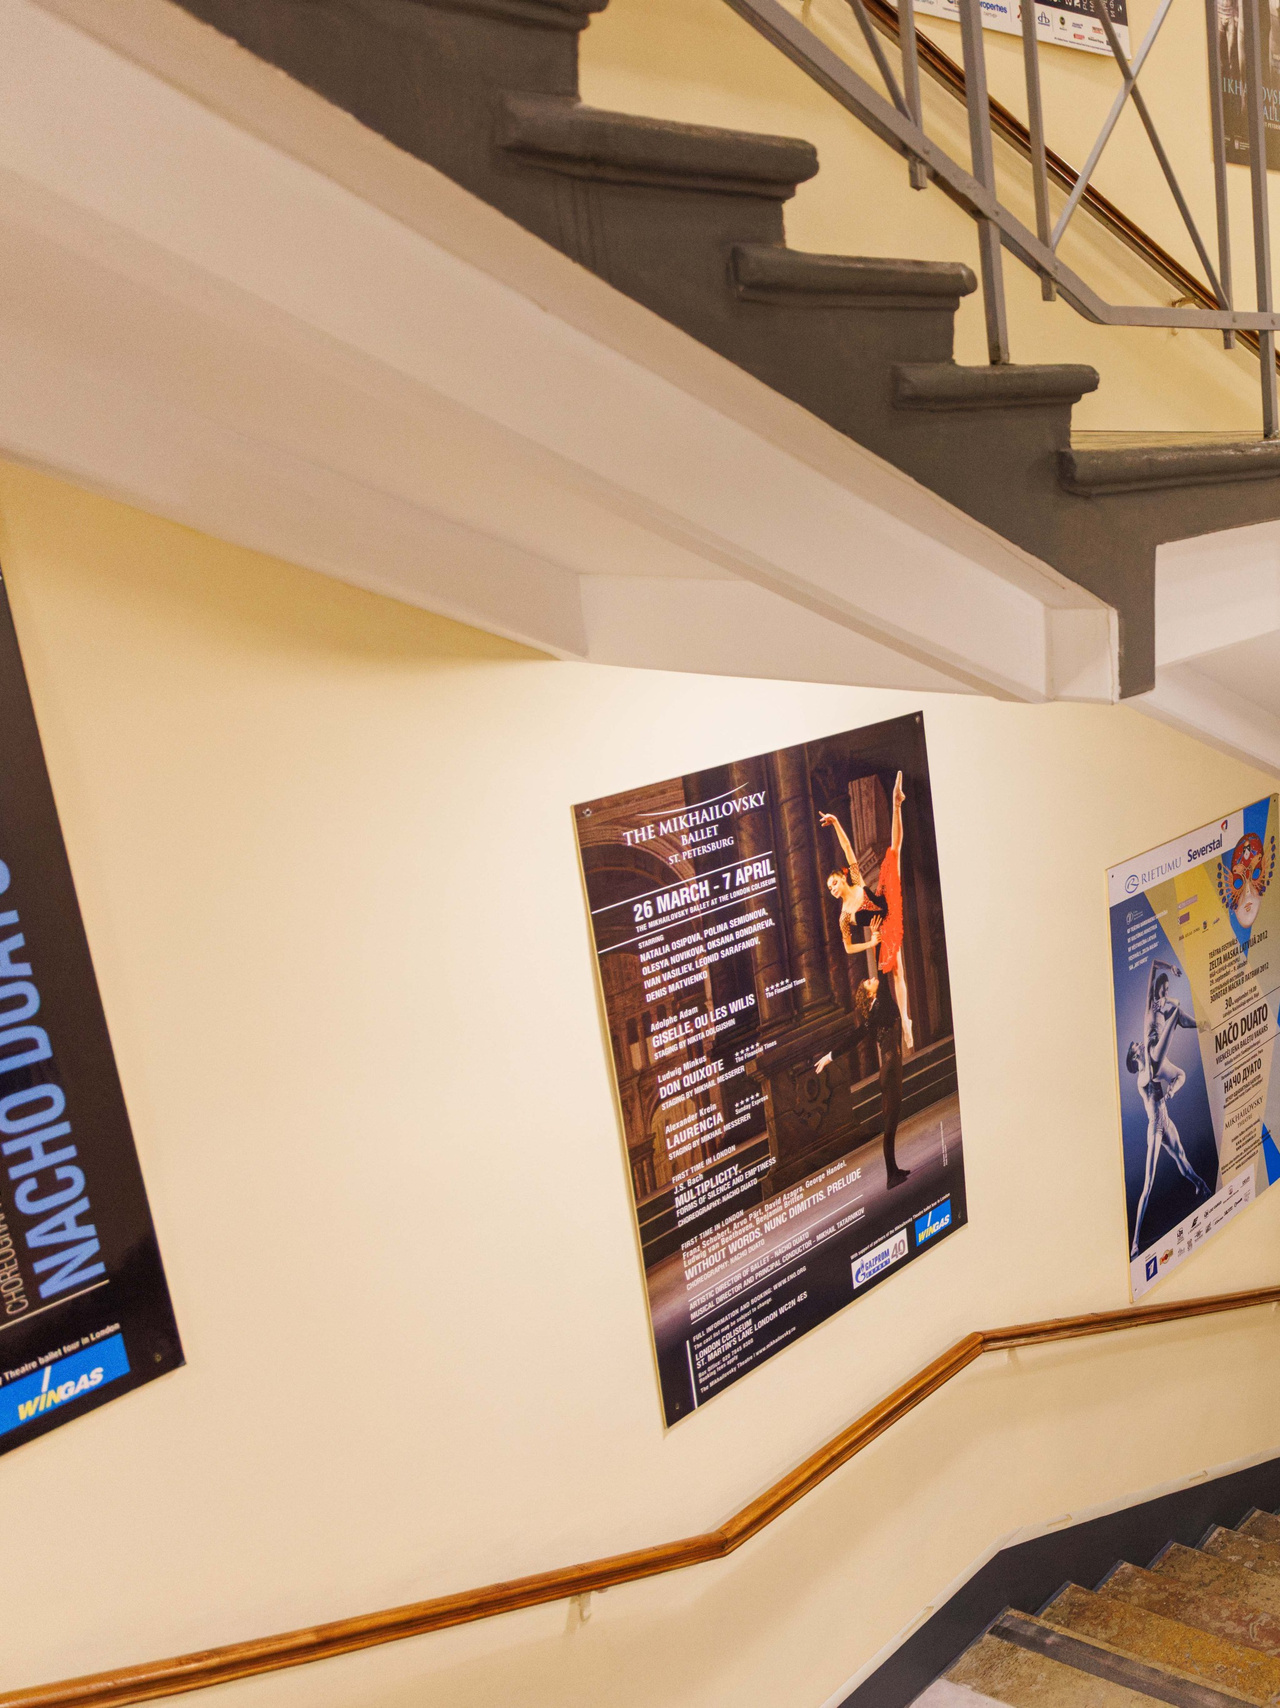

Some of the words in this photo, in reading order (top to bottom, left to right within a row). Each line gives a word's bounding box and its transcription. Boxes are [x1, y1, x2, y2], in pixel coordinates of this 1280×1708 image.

[622, 825, 655, 846] THE
[658, 792, 766, 835] MIKHAILOVSKY
[681, 825, 719, 845] BALLET
[668, 854, 679, 864] ST.
[682, 837, 734, 859] PETERSBURG
[1187, 834, 1222, 862] Severstal
[633, 900, 653, 921] 26
[656, 880, 709, 913] MARCH
[722, 872, 732, 890] 7
[734, 858, 774, 885] APRIL
[1141, 857, 1181, 884] RIETUMU
[636, 924, 647, 932] THE
[648, 909, 688, 927] MIKHAILOVSKY
[689, 901, 709, 912] BALLET
[710, 897, 717, 906] AT
[719, 894, 728, 902] THE
[730, 887, 749, 898] LONDON
[751, 877, 775, 890] COLISEUM
[638, 935, 664, 948] STARRING
[640, 944, 670, 962] NATALIA
[671, 932, 703, 950] OSIPOVA,
[703, 922, 728, 937] POLINA
[729, 907, 768, 928] SEMIONOVA,
[642, 958, 669, 975] OLESYA
[670, 944, 706, 964] NOVIKOVA,
[707, 934, 733, 950] OKSANA
[735, 918, 774, 939] BONDAREVA,
[644, 976, 660, 988] IVAN
[662, 962, 694, 981] VASILIEV,
[695, 952, 719, 968] LEONID
[720, 936, 760, 958] SARAFANOV,
[646, 987, 666, 1001] DENIS
[668, 971, 707, 992] MATVIENKO
[774, 983, 792, 994] Financial
[793, 977, 805, 985] Times
[650, 1014, 677, 1032] Adolphe
[679, 1005, 698, 1019] Adam
[652, 1020, 693, 1048] GISELLE,
[694, 1014, 707, 1029] OU
[709, 1005, 727, 1022] LES
[728, 993, 755, 1014] WILIS
[1215, 1018, 1238, 1052] NAČO
[1240, 1003, 1267, 1035] DUATO
[654, 1044, 677, 1059] STAGING
[678, 1040, 686, 1048] BY
[687, 1032, 705, 1044] NIKITA
[705, 1018, 735, 1036] DOLGUSHIN
[744, 1046, 763, 1058] Financial
[764, 1040, 776, 1049] Times
[658, 1066, 681, 1083] Ludwig
[683, 1055, 706, 1070] Minkus
[659, 1079, 680, 1098] DON
[682, 1059, 723, 1087] QUIXOTE
[661, 1094, 684, 1110] STAGING
[685, 1090, 693, 1098] BY
[694, 1079, 716, 1094] MIKHAIL
[717, 1066, 744, 1083] MESSERER
[1224, 1072, 1241, 1093] НАЧО
[1242, 1057, 1261, 1082] ДУАТО
[665, 1112, 697, 1133] Alexander
[699, 1103, 716, 1116] Krein
[735, 1103, 750, 1115] Sunday
[751, 1094, 768, 1107] Express
[1225, 1096, 1262, 1129] MIKHAILOVSKY
[666, 1112, 723, 1149] LAURENCIA
[668, 1143, 691, 1160] STAGING
[692, 1139, 699, 1147] BY
[700, 1128, 722, 1143] MIKHAIL
[723, 1113, 750, 1132] MESSERER
[671, 1169, 689, 1183] FIRST
[690, 1161, 704, 1173] TIME
[705, 1157, 711, 1165] IN
[713, 1145, 735, 1161] LONDON
[673, 1182, 685, 1193] J.S.
[687, 1173, 703, 1186] Bach
[805, 1172, 825, 1189] George
[0, 1083, 106, 1299] NACHO
[674, 1163, 741, 1207] MULTIPLICITY.
[676, 1200, 697, 1216] FORMS
[698, 1195, 706, 1204] OF
[707, 1182, 730, 1199] SILENCE
[731, 1174, 744, 1186] AND
[744, 1157, 776, 1179] EMPTINESS
[677, 1198, 721, 1227] CHOREOGRAPHY:
[722, 1188, 739, 1202] NACHO
[740, 1178, 757, 1192] DUATO
[681, 1236, 697, 1250] FIRST
[699, 1227, 713, 1239] TIME
[721, 1210, 743, 1226] LONDON
[684, 1247, 726, 1280] WITHOUT
[728, 1226, 762, 1254] WORDS.
[764, 1212, 787, 1233] NUNC
[788, 1189, 825, 1218] DIMITTIS.
[827, 1168, 861, 1195] PRELUDE
[918, 1214, 949, 1242] WINGAS
[890, 1238, 905, 1261] 40
[3, 1361, 38, 1381] Theatre
[38, 1348, 62, 1365] ballet
[62, 1341, 80, 1354] tour
[81, 1337, 90, 1345] in
[90, 1322, 120, 1341] London
[695, 1339, 720, 1360] LONDON
[721, 1319, 751, 1343] COLISEUM
[18, 1367, 104, 1420] WINGAS
